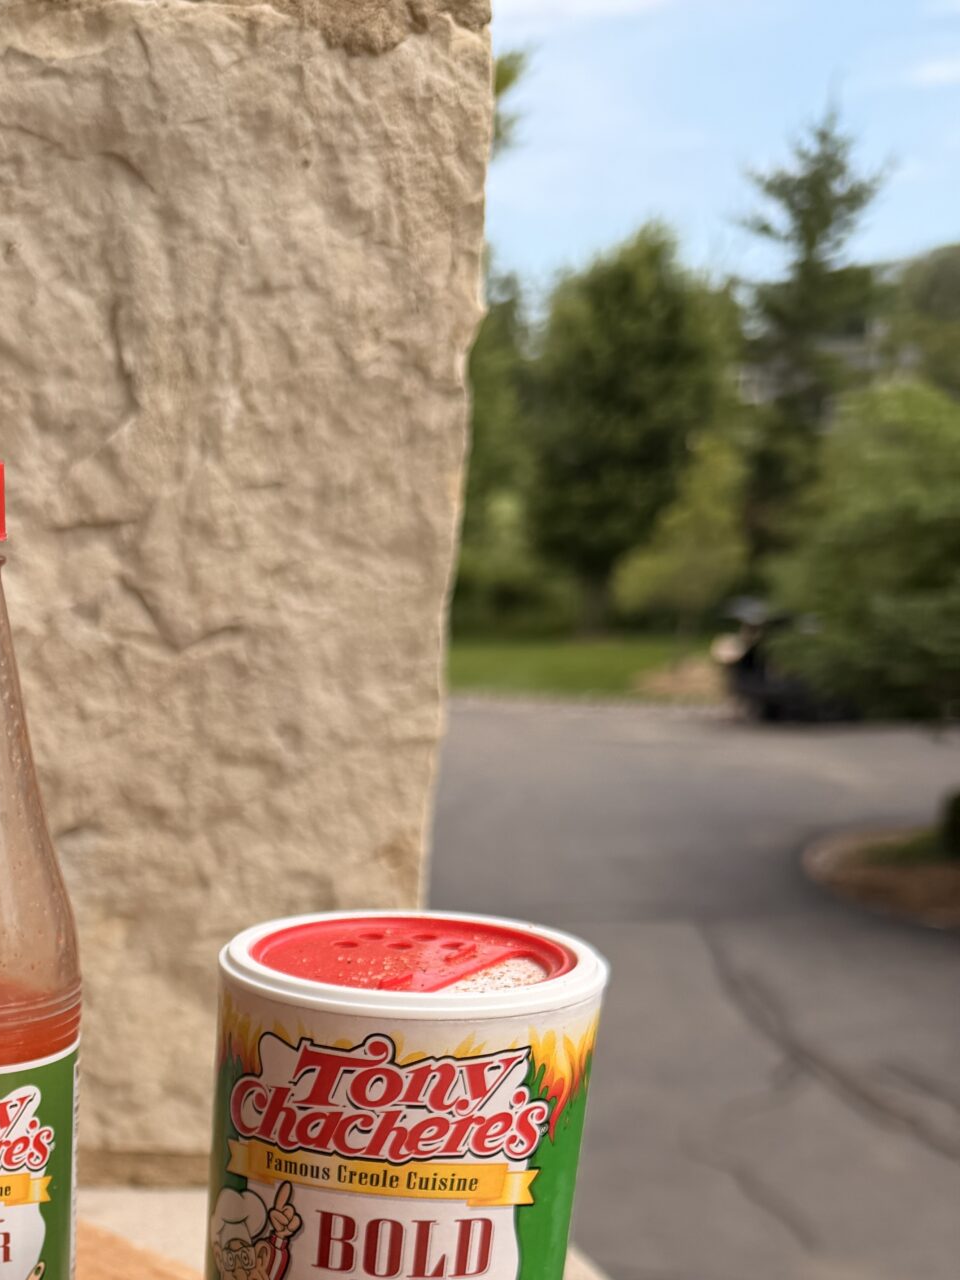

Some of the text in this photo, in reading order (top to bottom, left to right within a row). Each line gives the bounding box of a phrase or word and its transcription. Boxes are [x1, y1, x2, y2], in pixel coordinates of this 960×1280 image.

[293, 1041, 526, 1113] Tony
[232, 1080, 548, 1162] Chachere's
[266, 1151, 479, 1193] Famous Creole Cuisine
[312, 1209, 494, 1280] BOLD
